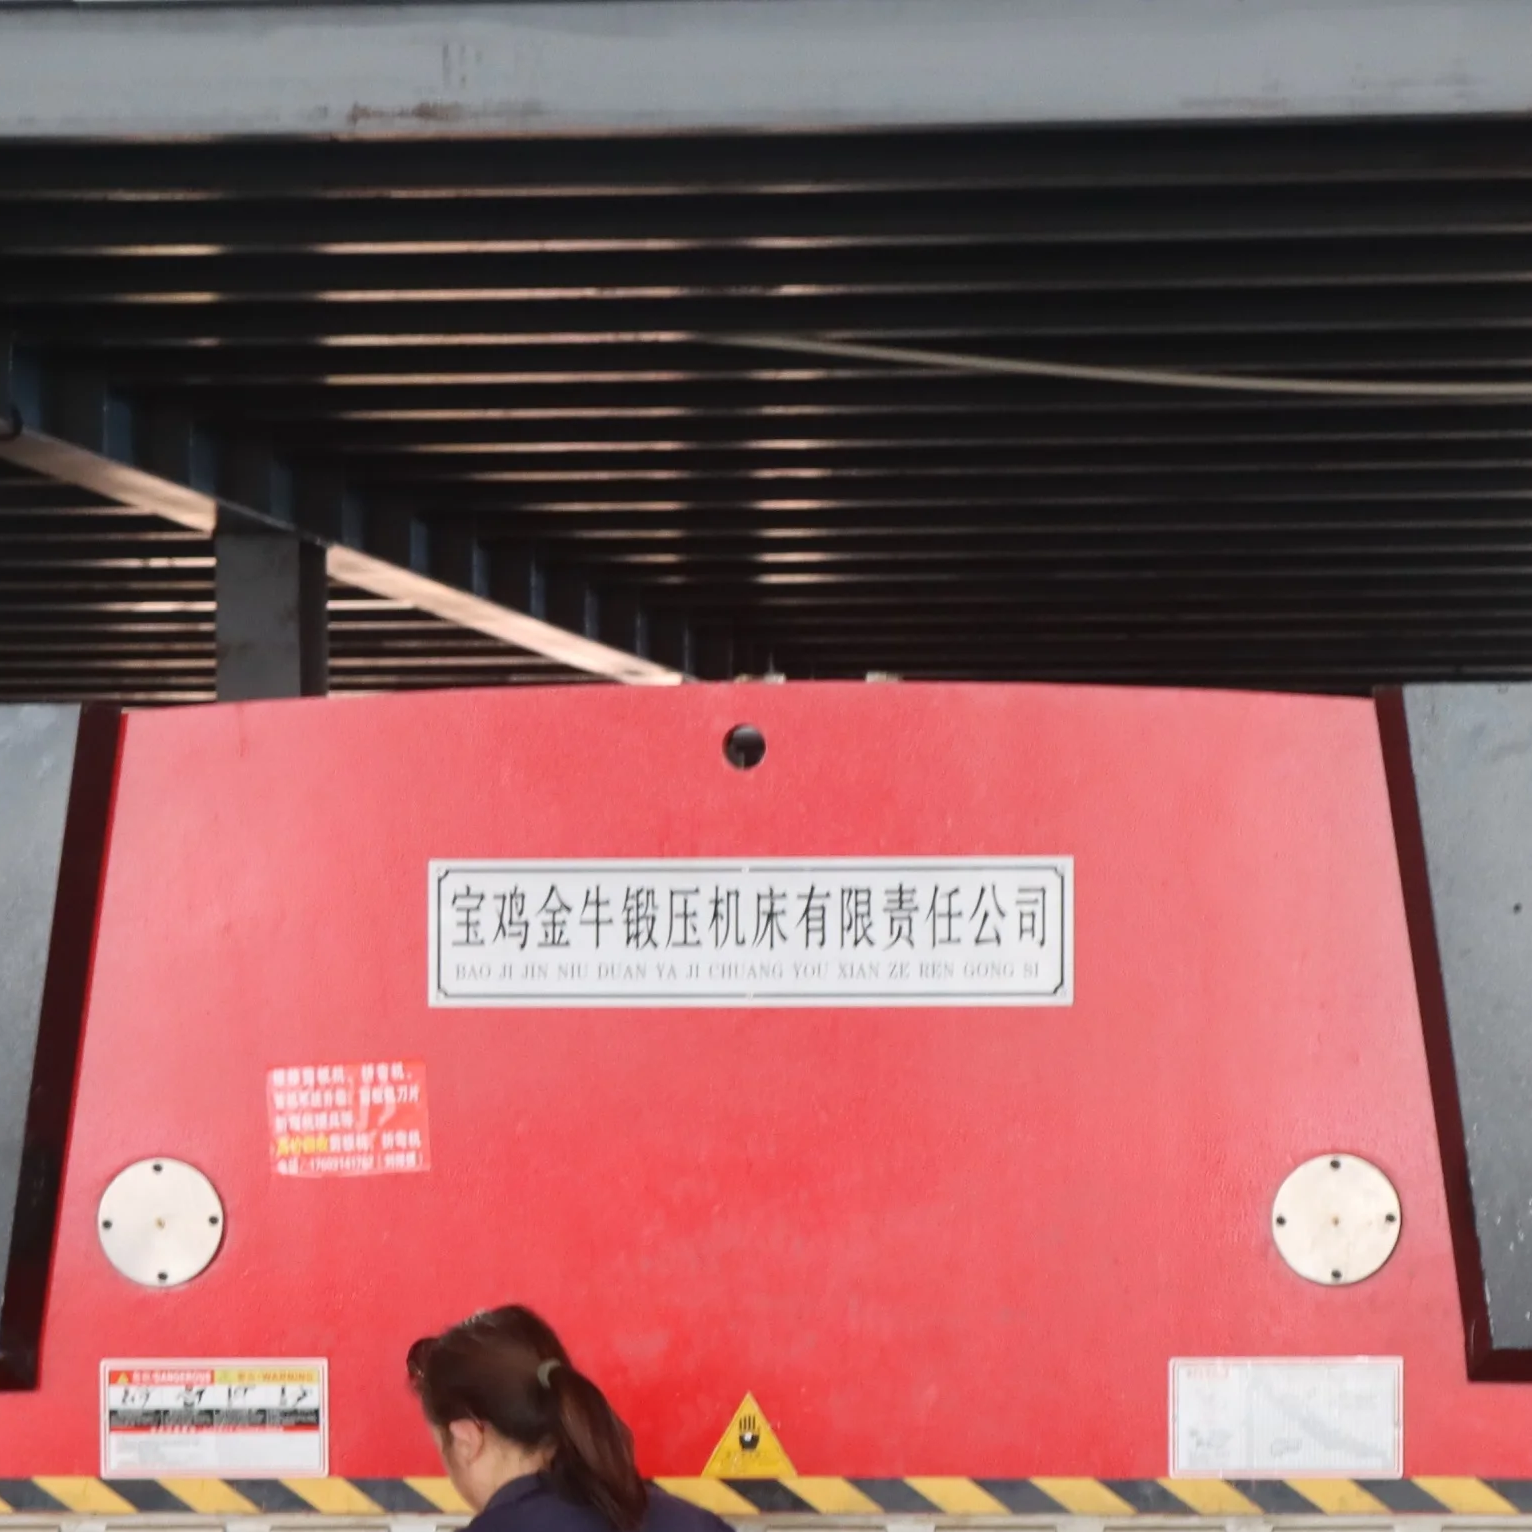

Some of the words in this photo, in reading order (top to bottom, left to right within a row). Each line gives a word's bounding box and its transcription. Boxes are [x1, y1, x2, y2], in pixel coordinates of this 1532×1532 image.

[450, 883, 1049, 952] 宝鸡金牛锻压机床有限责任公司
[455, 961, 491, 982] BAO
[498, 961, 513, 982] JI
[520, 961, 548, 982] JIN
[556, 961, 588, 982] NIU
[597, 961, 647, 982] DUAN
[655, 961, 678, 982] YA
[684, 961, 700, 982] JI
[708, 961, 783, 982] CHUANG
[792, 961, 829, 982] YOU
[837, 961, 880, 982] XIAN
[888, 961, 910, 982] ZE
[919, 961, 954, 982] REN
[963, 961, 1014, 982] GONG
[1022, 961, 1039, 982] SI
